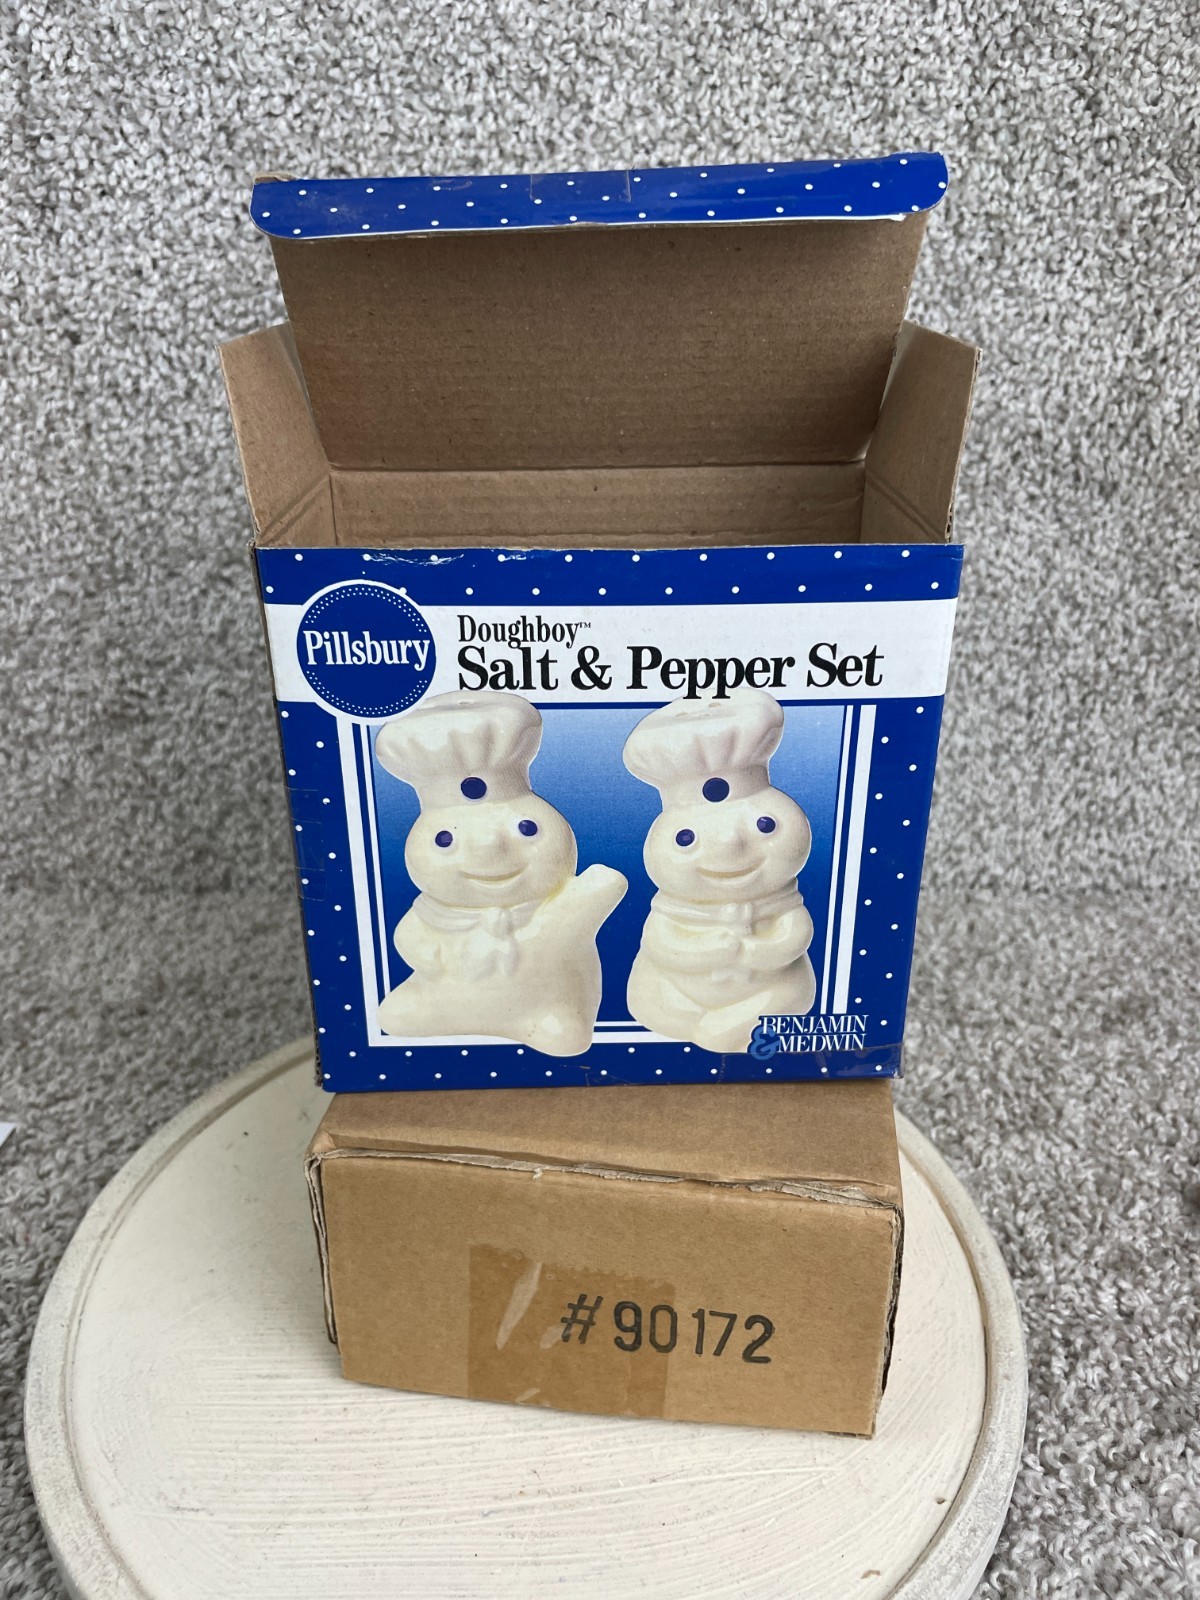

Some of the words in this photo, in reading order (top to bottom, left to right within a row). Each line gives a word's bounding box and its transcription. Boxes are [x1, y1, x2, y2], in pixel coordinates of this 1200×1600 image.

[303, 630, 430, 671] Pillsbury
[457, 645, 559, 691] Salt
[570, 645, 613, 691] &
[626, 645, 796, 700] Pepper
[806, 642, 885, 688] Set
[761, 1014, 869, 1035] BENJAMIN
[777, 1033, 867, 1053] MEDWIN
